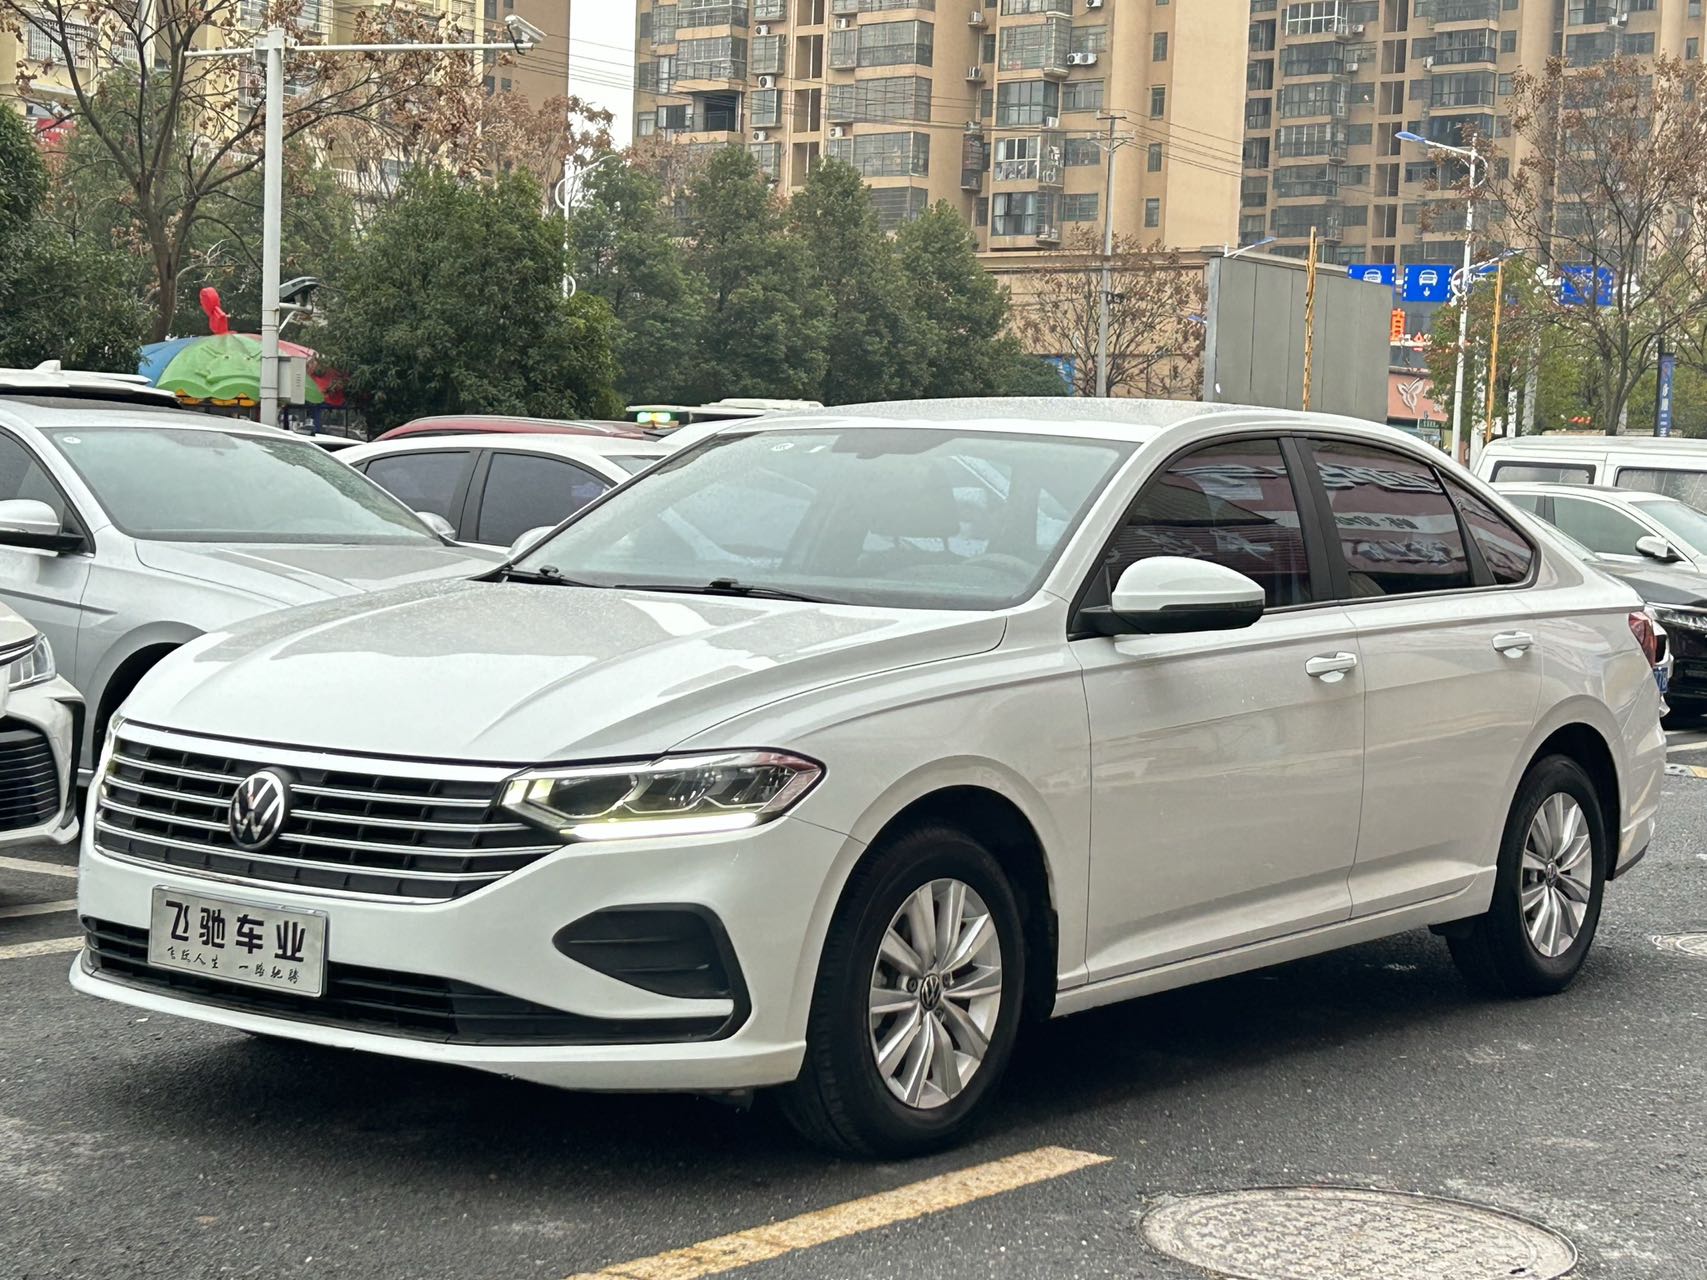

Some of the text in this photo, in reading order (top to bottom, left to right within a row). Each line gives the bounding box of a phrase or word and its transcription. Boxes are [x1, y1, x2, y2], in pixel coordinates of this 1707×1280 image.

[229, 771, 285, 849] VW
[165, 899, 306, 963] 飞驰车业
[166, 945, 220, 969] 飞跃人生
